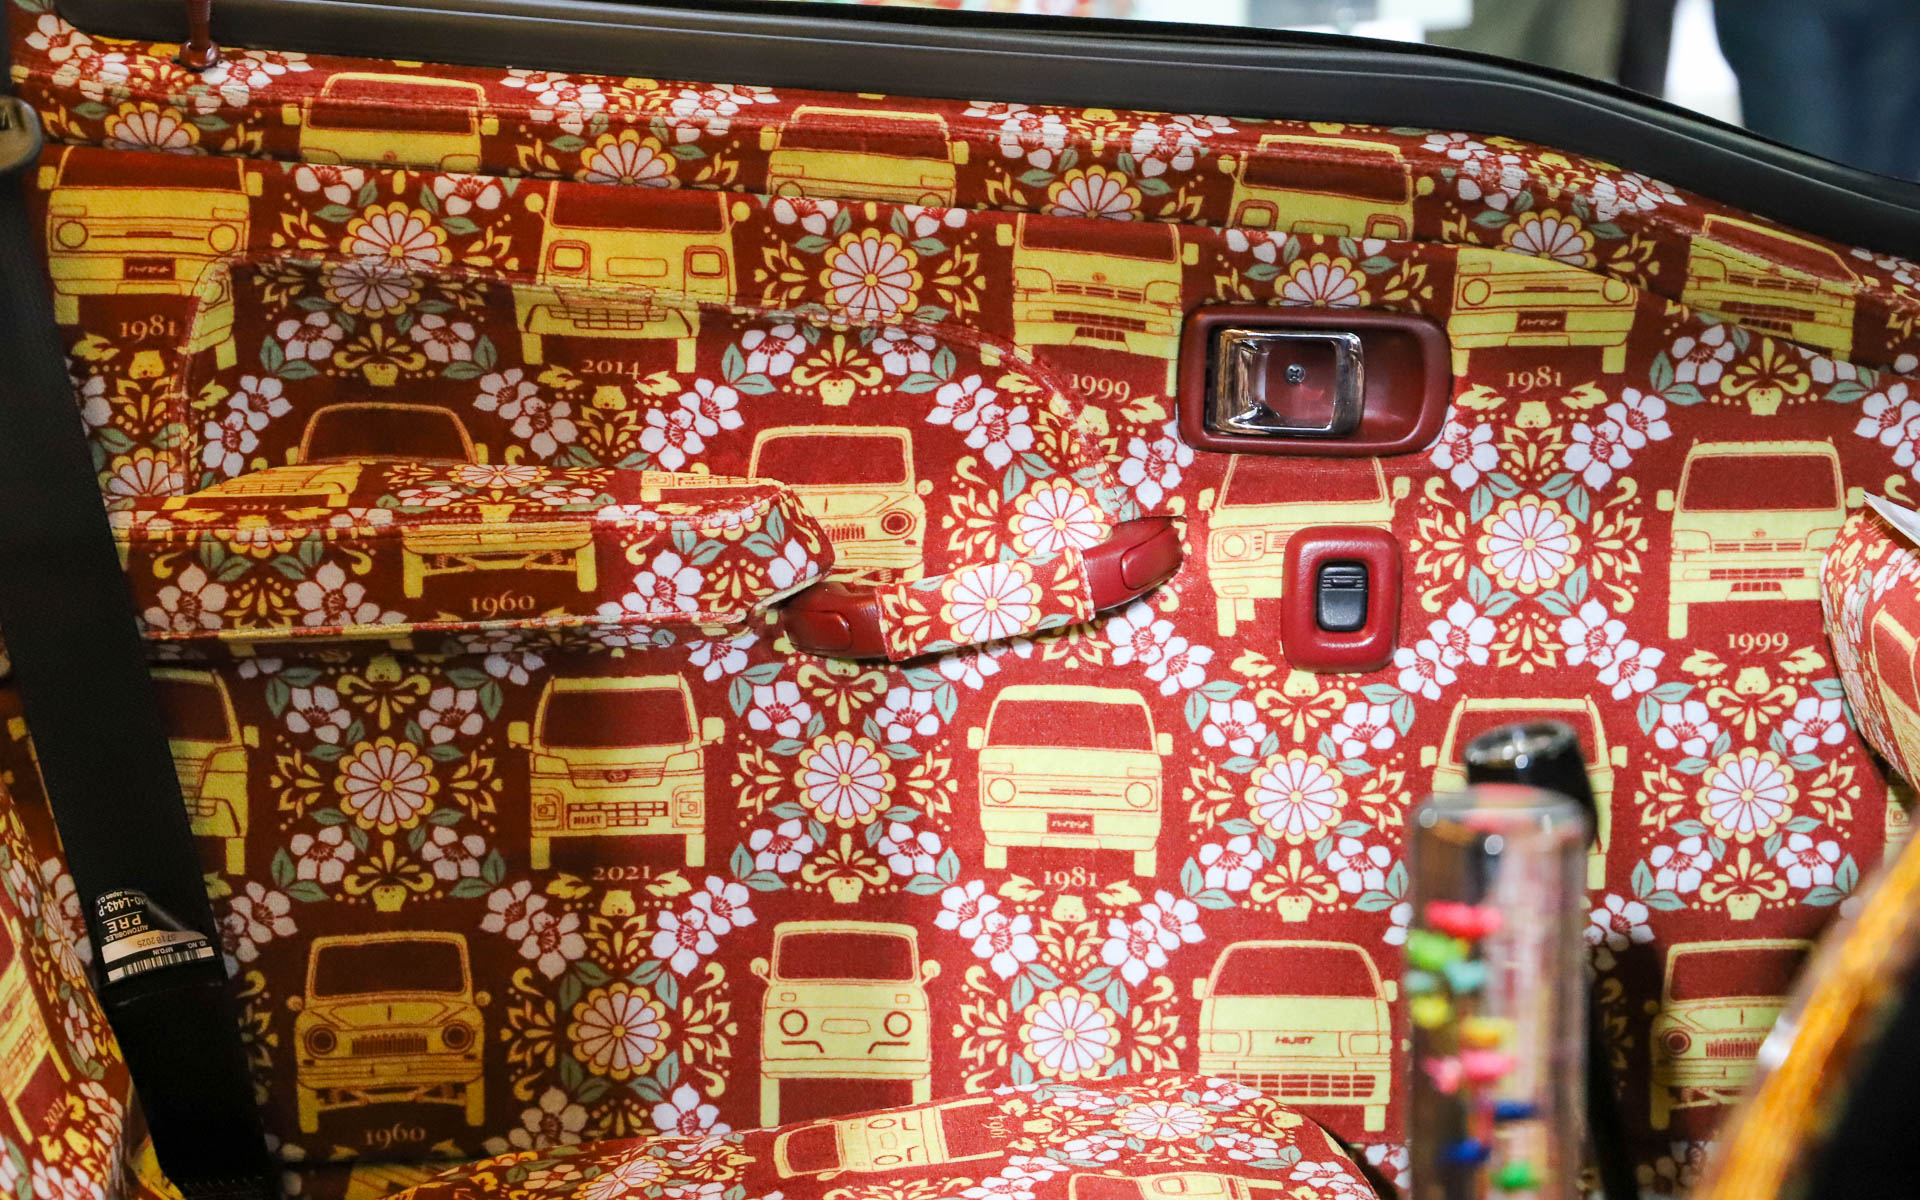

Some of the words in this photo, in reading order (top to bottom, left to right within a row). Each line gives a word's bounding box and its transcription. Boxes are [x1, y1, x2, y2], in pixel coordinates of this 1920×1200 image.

[120, 314, 175, 343] 1981
[580, 359, 640, 380] 2014
[1506, 366, 1562, 393] 1981
[1069, 373, 1130, 403] 1999
[471, 590, 535, 619] 1960
[1726, 632, 1789, 655] 1999
[592, 865, 650, 881] 2021
[1044, 866, 1098, 892] 1981
[106, 914, 142, 934] PRE
[363, 1122, 427, 1150] 1960
